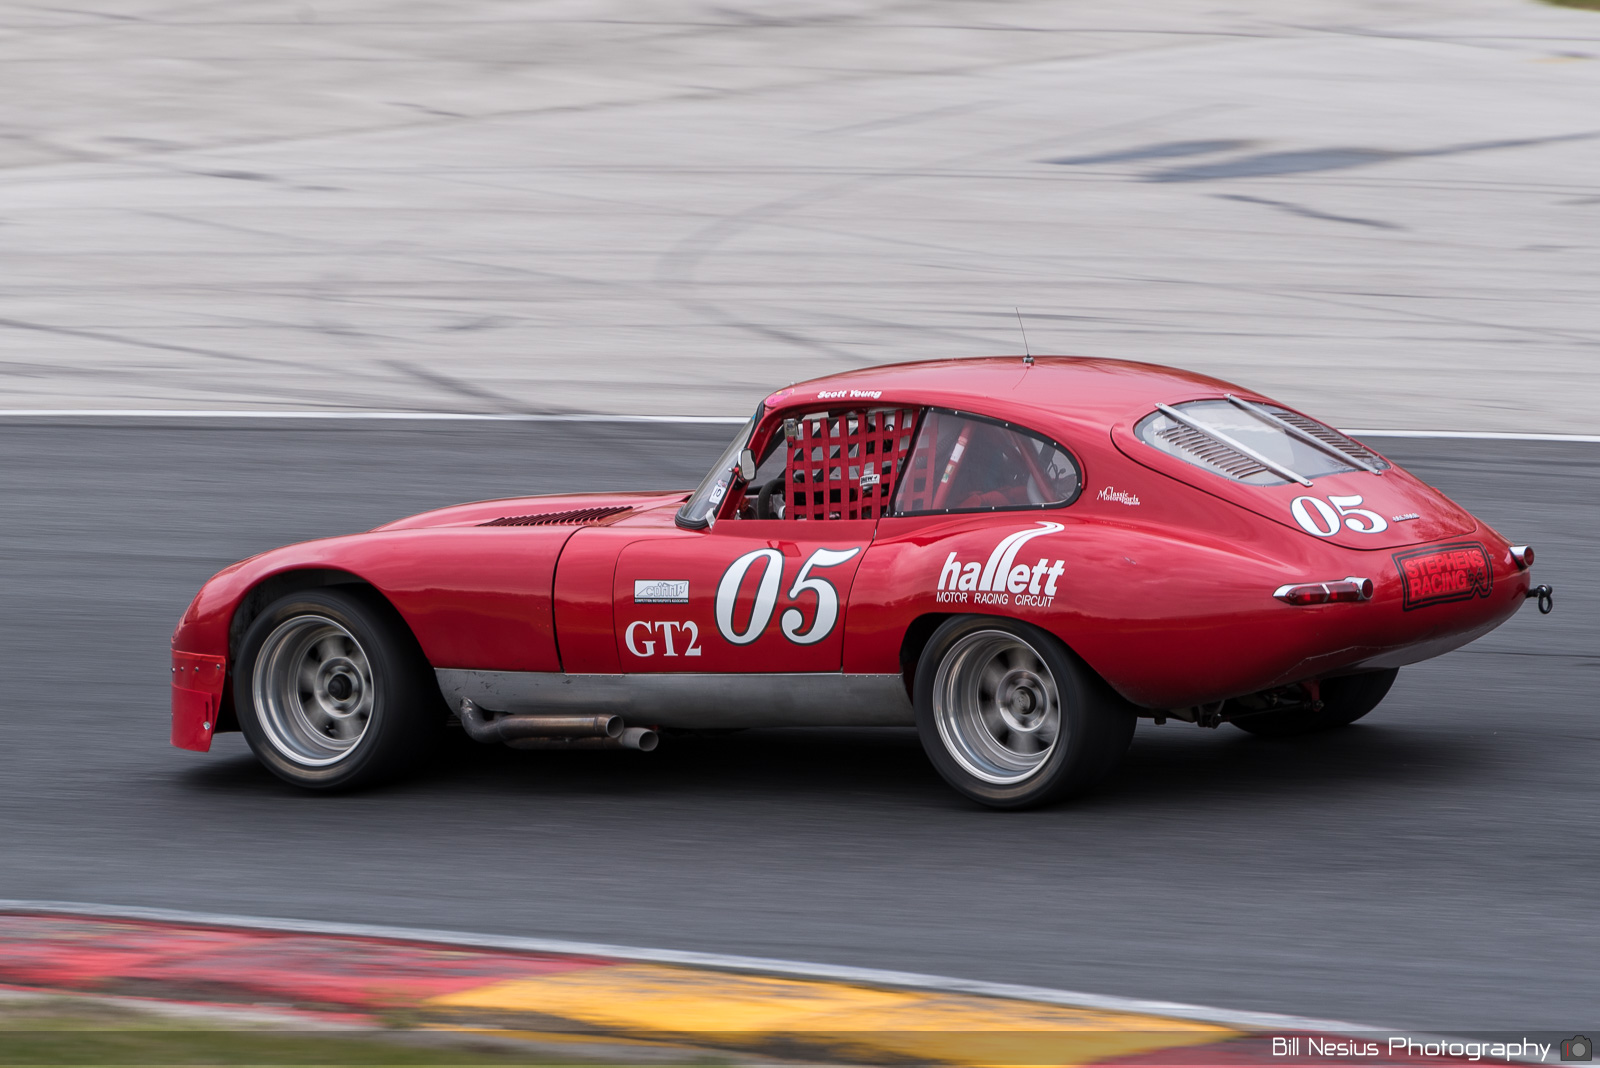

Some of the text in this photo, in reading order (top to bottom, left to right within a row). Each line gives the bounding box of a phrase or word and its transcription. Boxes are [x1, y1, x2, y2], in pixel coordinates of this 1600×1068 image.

[817, 389, 882, 399] Scott Young
[1096, 489, 1139, 503] Motorsports
[1290, 494, 1389, 537] 05
[937, 521, 1065, 596] hallett
[1404, 549, 1485, 578] STEPHENS
[713, 547, 862, 646] 05
[1410, 570, 1467, 598] RACING
[936, 591, 1054, 608] MOTOR RACING CIRCUIT
[625, 620, 702, 657] GT2
